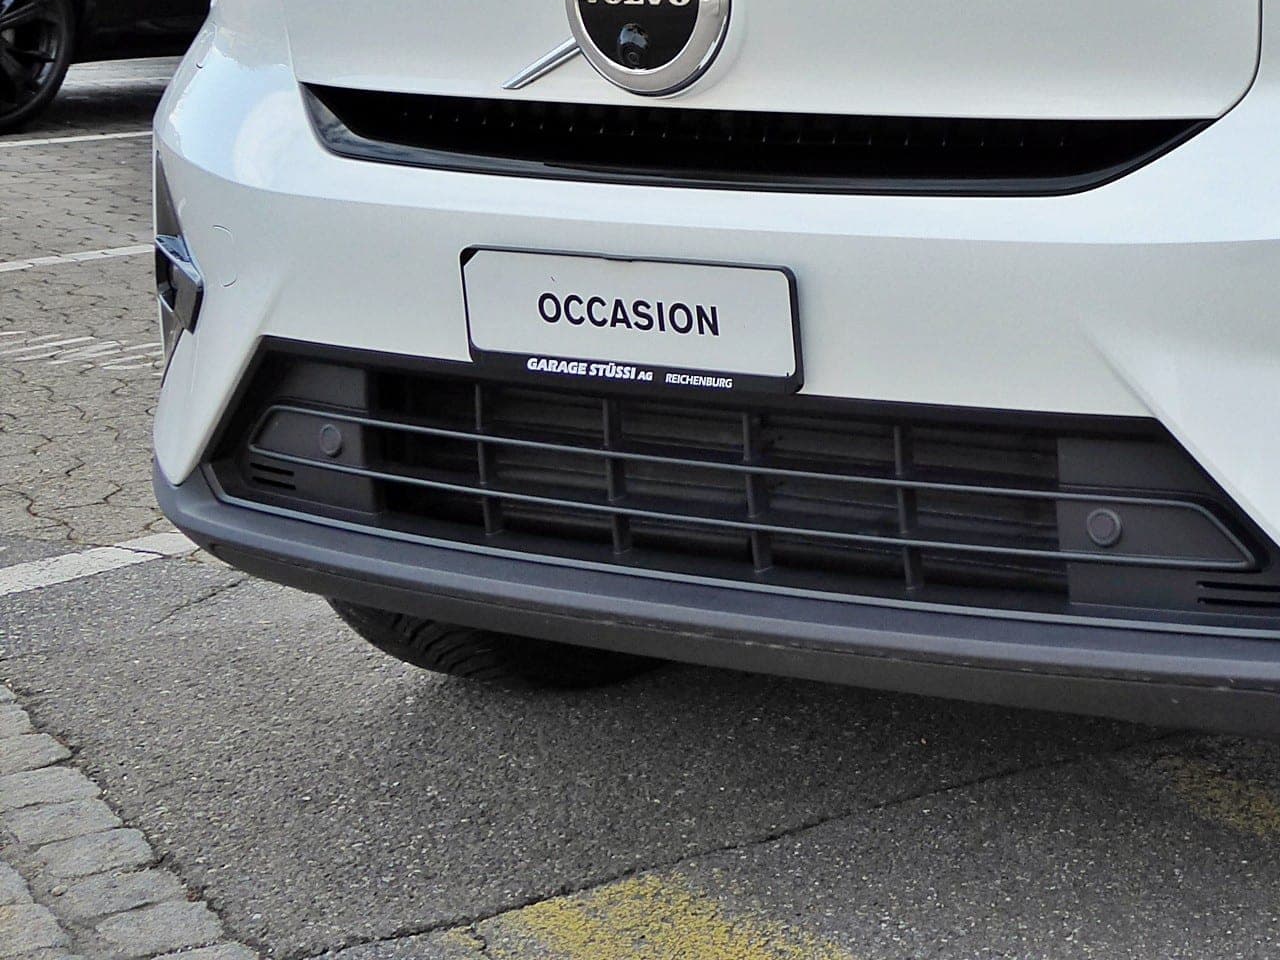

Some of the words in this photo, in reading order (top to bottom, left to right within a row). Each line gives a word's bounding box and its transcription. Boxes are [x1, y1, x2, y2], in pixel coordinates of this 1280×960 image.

[538, 292, 720, 336] OCCASION
[527, 358, 587, 375] GARAGE
[588, 362, 636, 380] STÜSSI
[637, 371, 653, 381] AG
[665, 373, 733, 389] REICHENBURG
